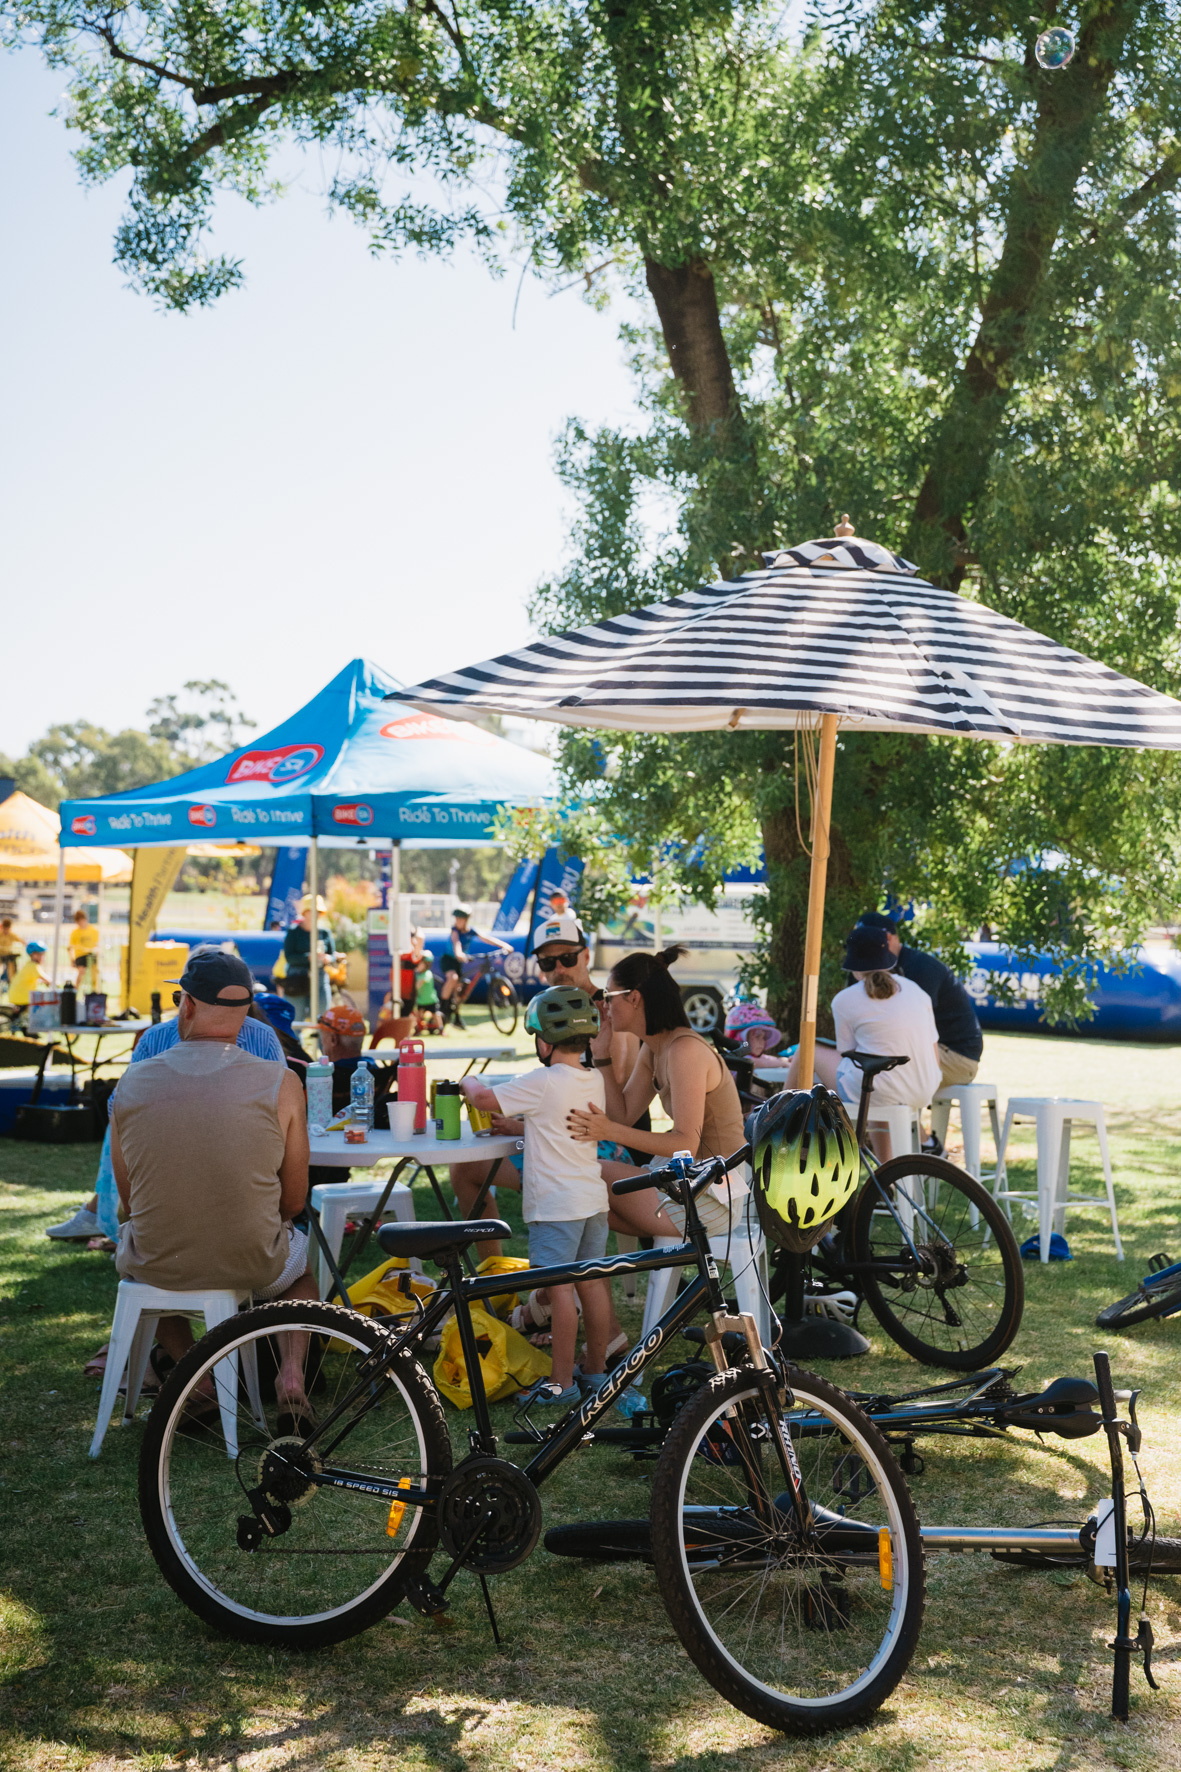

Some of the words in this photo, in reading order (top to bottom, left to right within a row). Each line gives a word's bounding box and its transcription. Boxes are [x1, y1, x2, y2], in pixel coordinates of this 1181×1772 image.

[334, 808, 355, 821] BIKE
[399, 806, 432, 823] Ride
[432, 808, 449, 823] To
[449, 808, 491, 824] Thrive
[580, 1326, 663, 1426] REPCO
[346, 1481, 380, 1494] SPEED
[382, 1488, 399, 1497] SIS
